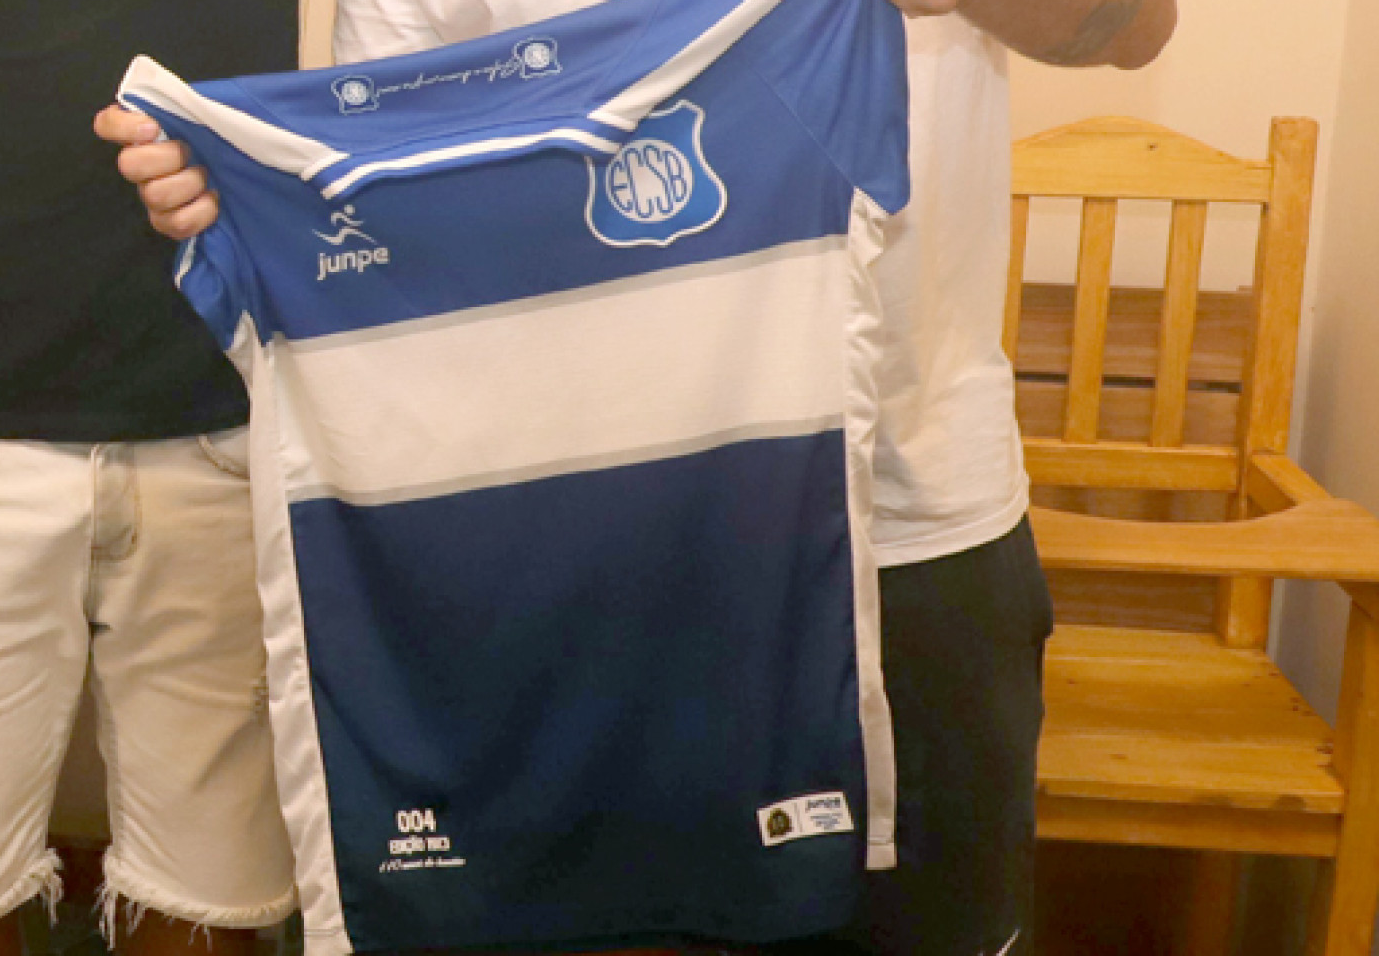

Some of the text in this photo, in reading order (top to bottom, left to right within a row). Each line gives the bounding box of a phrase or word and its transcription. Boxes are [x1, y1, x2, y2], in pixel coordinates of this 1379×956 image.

[609, 144, 689, 219] ECSB
[316, 247, 390, 282] junpe
[397, 808, 437, 833] 004
